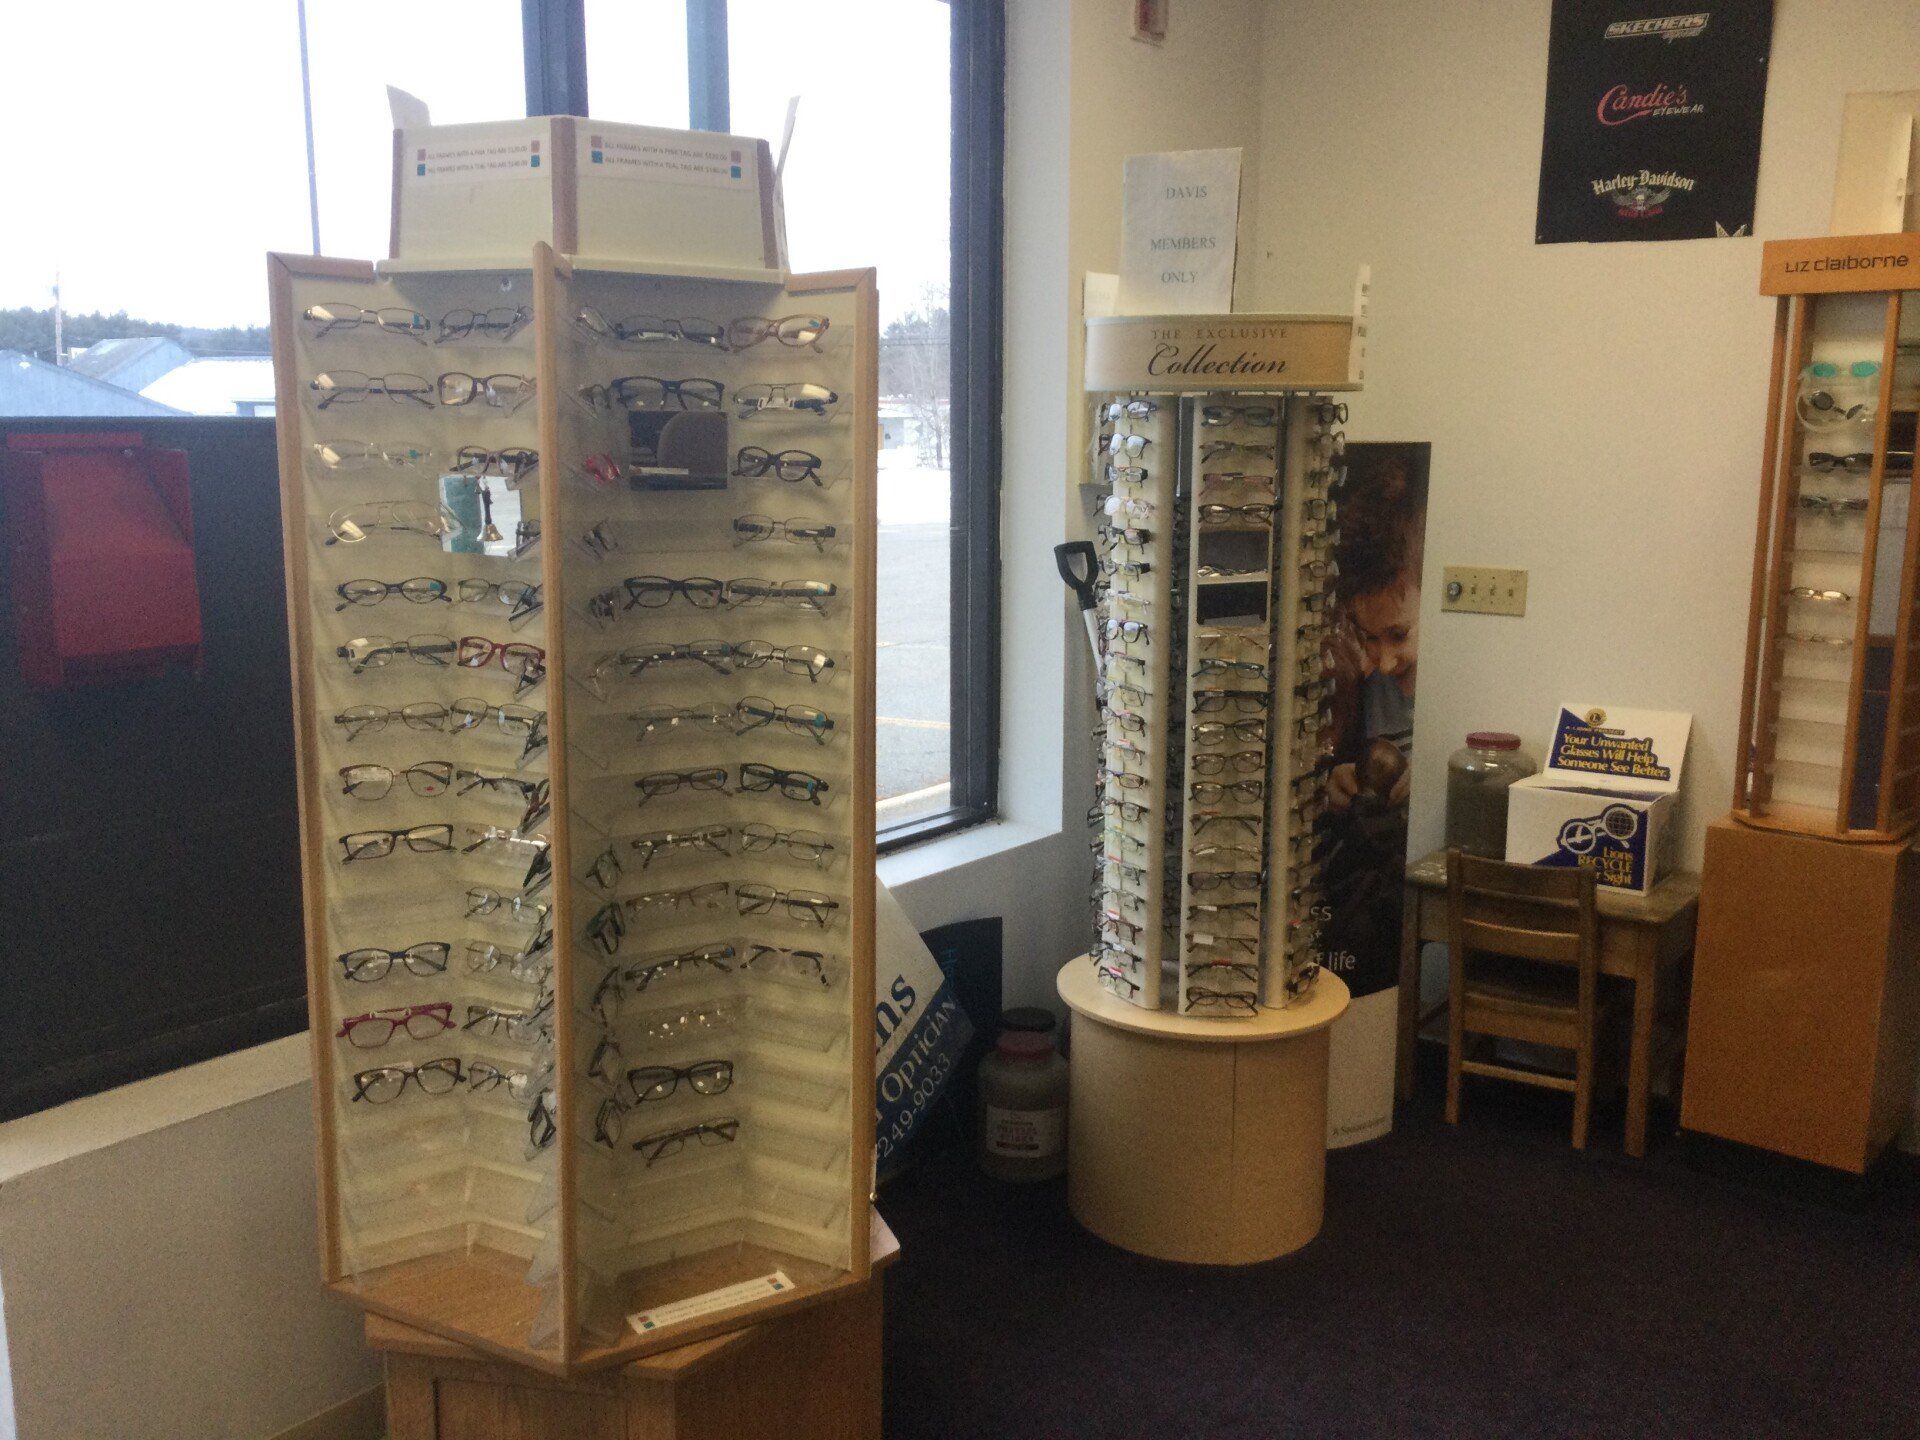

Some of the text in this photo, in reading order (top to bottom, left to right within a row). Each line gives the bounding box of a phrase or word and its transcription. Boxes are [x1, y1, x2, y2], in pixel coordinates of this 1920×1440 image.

[1607, 15, 1706, 37] SKECHERS
[1597, 82, 1689, 126] Candie's
[1653, 104, 1704, 117] EYEWEAR
[1592, 169, 1695, 196] Harley-Davidson
[1166, 185, 1208, 200] DAVIS
[1150, 236, 1216, 251] MEMBERS
[1814, 253, 1909, 272] claiborne
[1161, 271, 1199, 284] ONLY
[1151, 328, 1289, 340] THE EXCLUSIVE
[1147, 342, 1287, 376] Collection
[1563, 732, 1650, 752] Your Unwanted
[1560, 744, 1656, 766] Glasses Will Help
[1558, 756, 1608, 772] Someone
[1610, 761, 1631, 774] See
[1603, 847, 1634, 862] Lions
[1602, 870, 1633, 886] Sight
[1328, 949, 1356, 972] life
